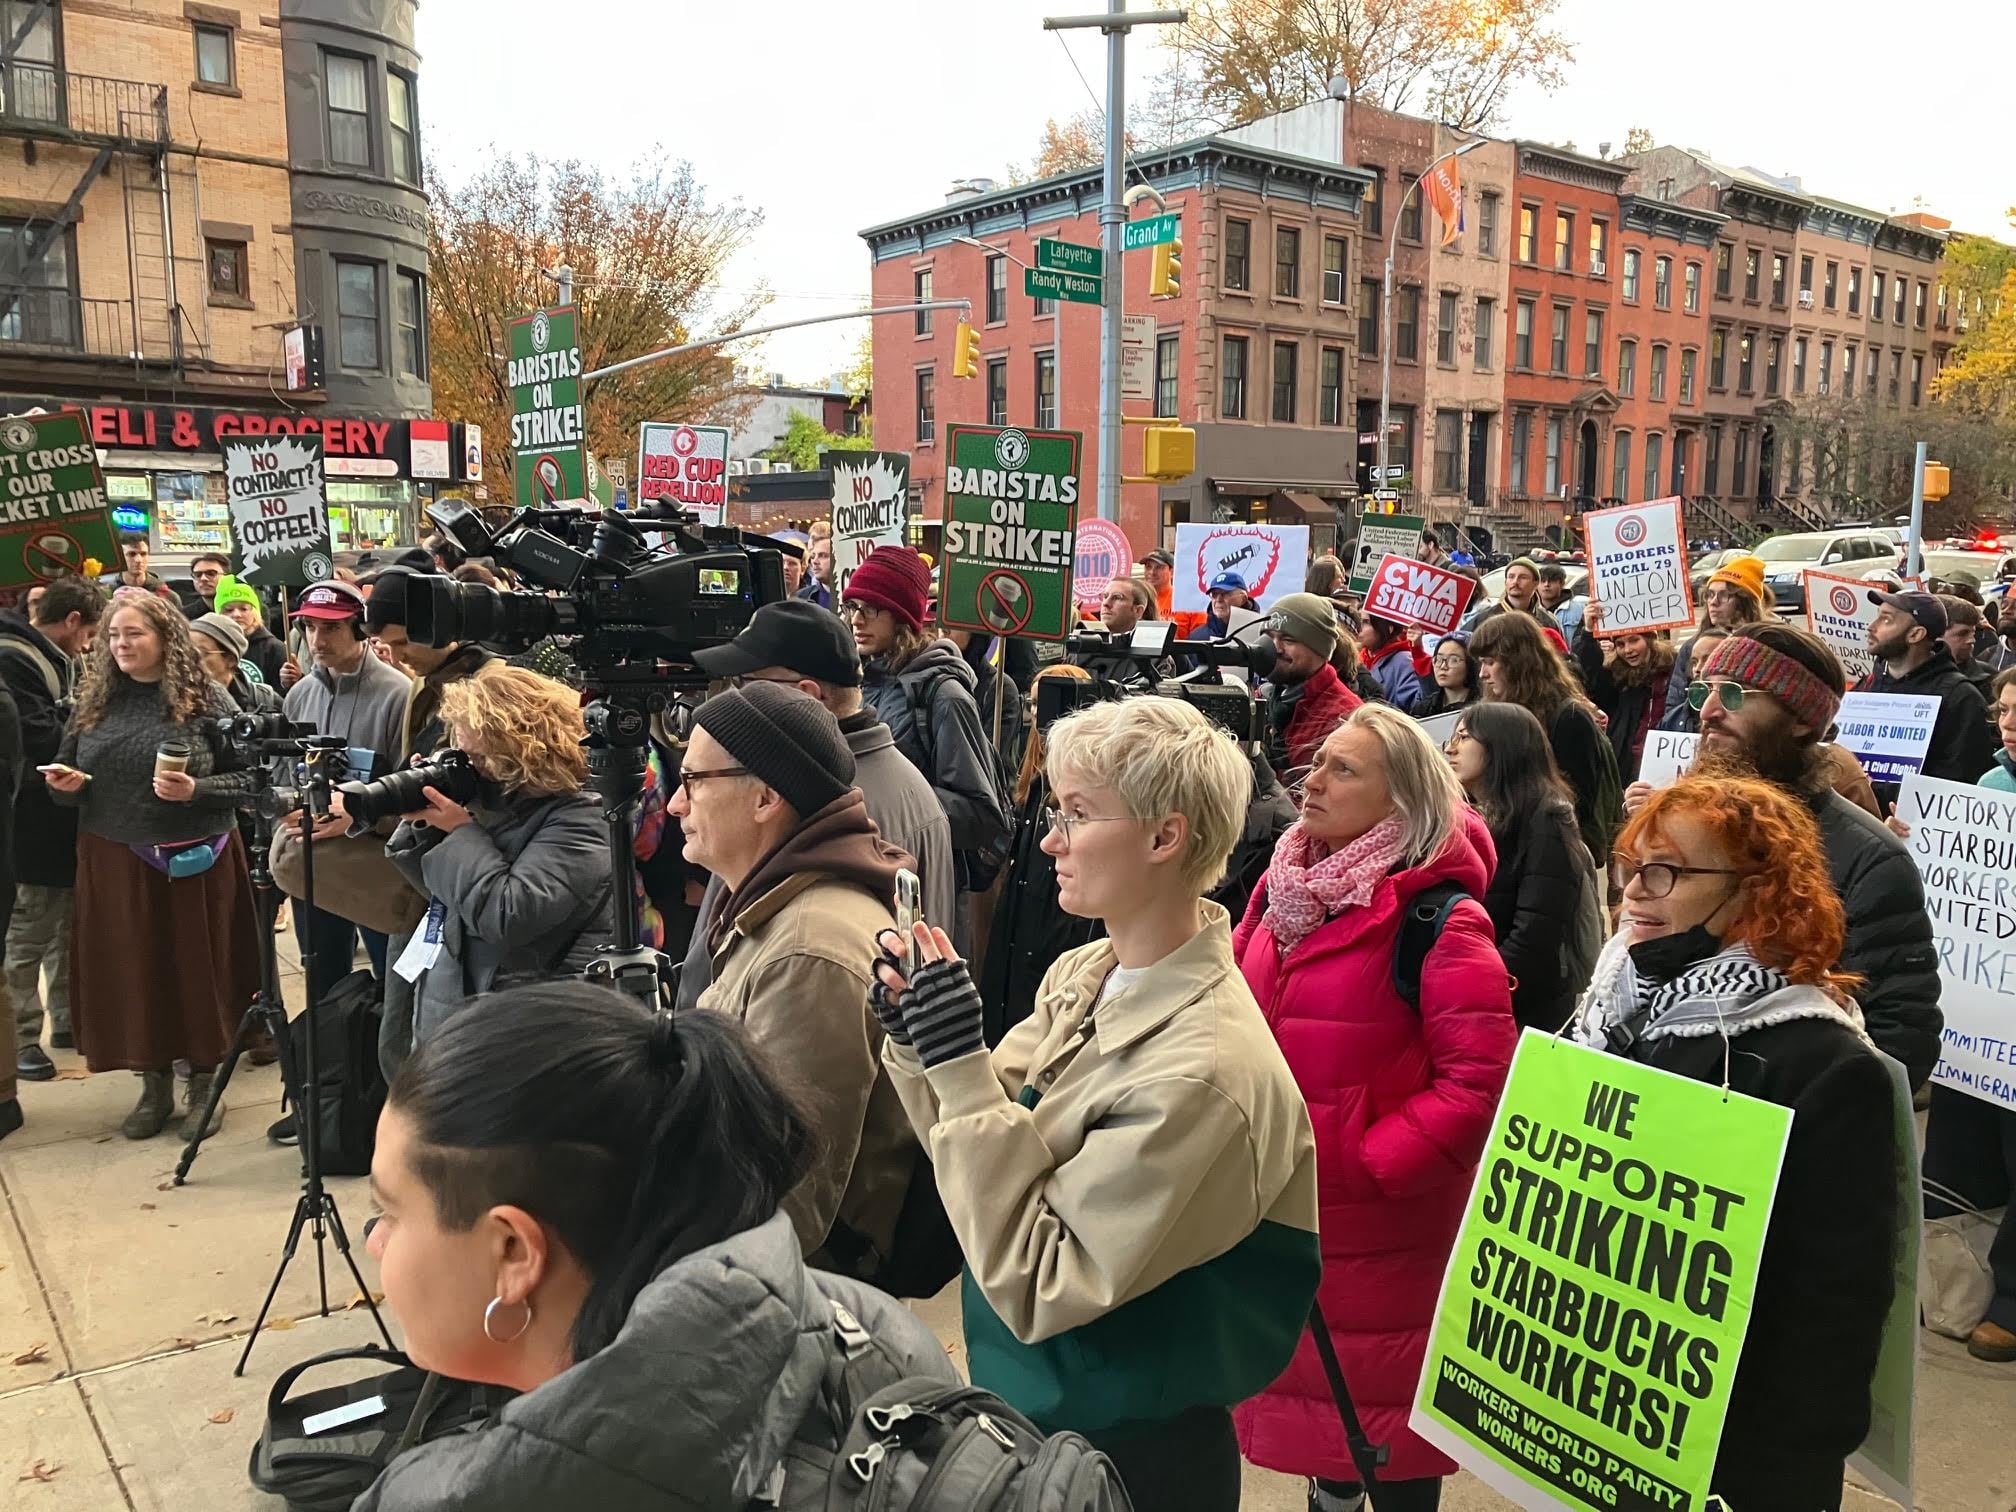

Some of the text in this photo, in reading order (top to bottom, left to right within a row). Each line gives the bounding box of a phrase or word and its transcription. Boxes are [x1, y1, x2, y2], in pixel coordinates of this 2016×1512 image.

[1126, 218, 1172, 247] Grand Av
[1050, 242, 1093, 264] Lafayette
[1032, 271, 1096, 294] Randy Weston
[1059, 291, 1070, 300] Way
[508, 347, 581, 388] BARISTAS
[533, 383, 553, 409] ON
[61, 404, 157, 446] ELI
[171, 411, 200, 447] &
[511, 405, 584, 448] STRIKE!
[26, 443, 95, 471] CROSS
[250, 452, 279, 473] NO
[644, 454, 725, 483] RED CUP
[8, 473, 55, 497] OUR
[232, 463, 315, 497] CONTRACT?
[641, 478, 726, 506] REBELLION
[853, 476, 873, 502] NO
[947, 466, 1078, 504] BARISTAS
[58, 487, 107, 514] LINE
[259, 497, 288, 519] NO
[836, 494, 899, 534] CONTRACT?
[990, 499, 1025, 526] ON
[112, 511, 150, 526] ATM
[243, 506, 319, 546] COFFEE!
[855, 538, 875, 566] NO
[945, 520, 1073, 566] STRIKE!
[1596, 544, 1675, 566] LABORERS
[1601, 558, 1672, 578] LOCAL 79
[1385, 561, 1458, 606] CWA
[1596, 567, 1678, 603] UNION
[1376, 583, 1455, 628] STRONG
[1600, 593, 1685, 629] POWER
[1814, 612, 1869, 631] LABORE
[1818, 625, 1861, 641] LOCAL
[1914, 709, 1929, 718] UFT
[1842, 722, 1927, 741] LABOR IS UNITED
[1862, 739, 1875, 751] for
[1870, 761, 1890, 773] Civil
[1915, 791, 2016, 833] VICTORY
[1916, 827, 2016, 871] STARBU
[1926, 896, 2016, 939] NITED
[1933, 936, 2016, 996] RIKE
[1582, 1080, 1640, 1141] WE
[1504, 1114, 1746, 1232] SUPPORT
[1482, 1157, 1733, 1324] STRIKING
[1470, 1237, 1720, 1401] STARBUCKS
[1466, 1297, 1692, 1462] WORKERS!
[1443, 1360, 1684, 1510] WORKERS WORLD PARTY
